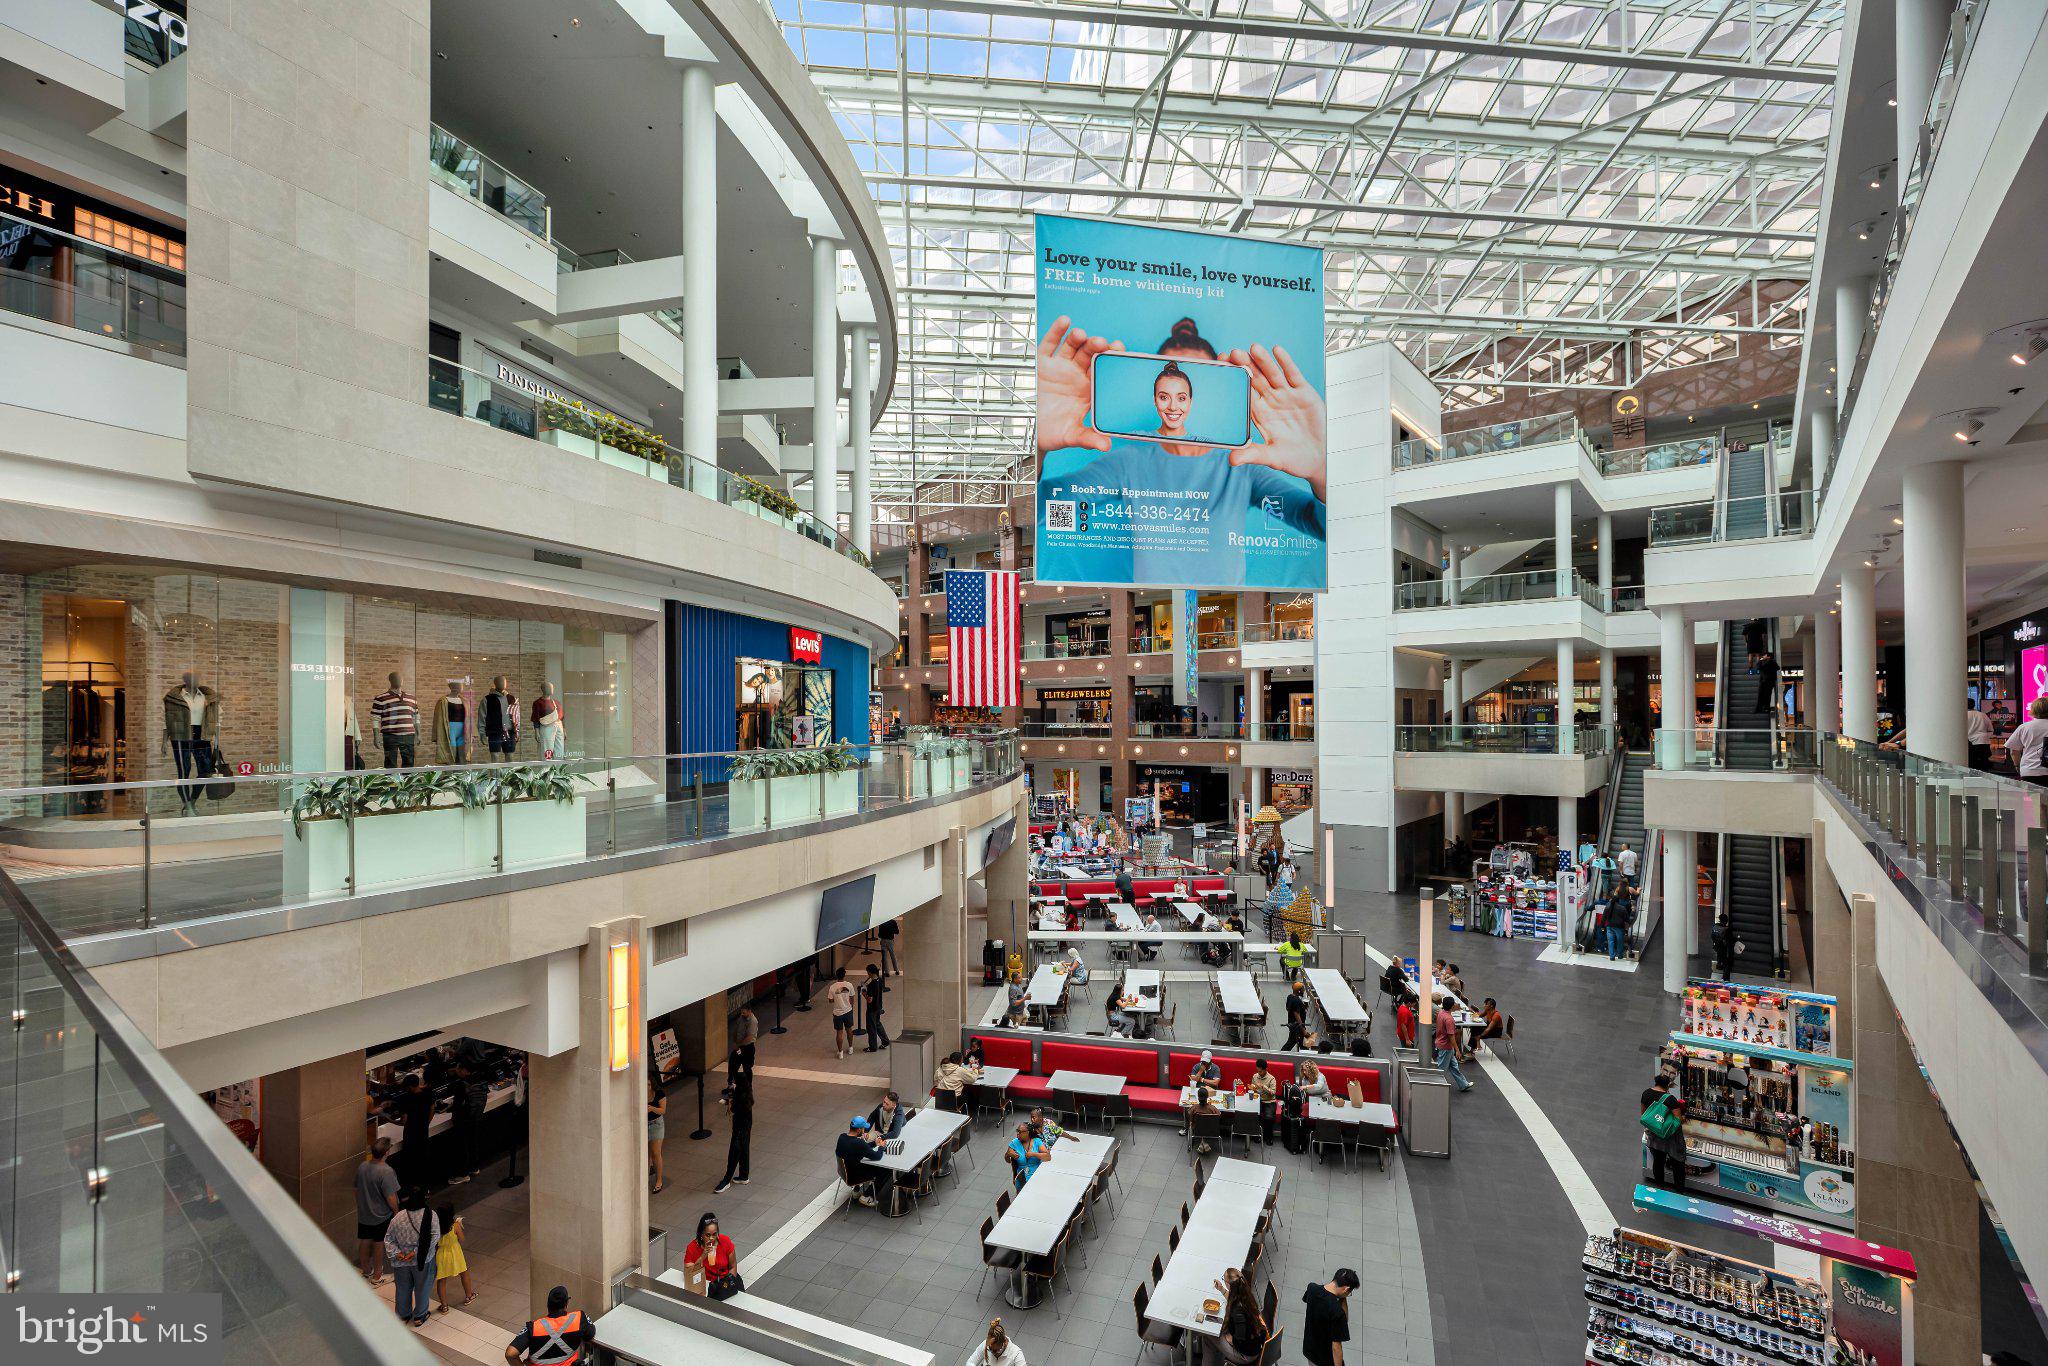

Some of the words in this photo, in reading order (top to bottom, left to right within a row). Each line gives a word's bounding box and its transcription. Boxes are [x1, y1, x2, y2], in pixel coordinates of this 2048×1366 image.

[1044, 247, 1090, 267] Love
[1095, 257, 1138, 273] your
[1142, 261, 1198, 282] smile,
[1201, 265, 1238, 284] love
[1241, 273, 1316, 293] yourself.
[1044, 267, 1085, 283] FREE
[1092, 273, 1132, 288] home
[1136, 279, 1204, 299] whitening
[1207, 285, 1225, 298] kit
[1070, 484, 1096, 494] Book
[1097, 485, 1120, 496] Your
[1121, 487, 1184, 499] Appointment
[1185, 490, 1210, 500] NOW
[1091, 502, 1210, 522] 1-844-336-2474
[1091, 522, 1210, 534] www.renovasmiles.com
[1228, 531, 1318, 549] RenovaSmiles
[1043, 691, 1065, 699] ELITE
[1070, 689, 1111, 699] JEWELERS
[1811, 1086, 1841, 1097] ISLAND
[1812, 1191, 1849, 1206] ISLAND
[1838, 1276, 1867, 1295] Sun
[1842, 1289, 1898, 1315] Shade
